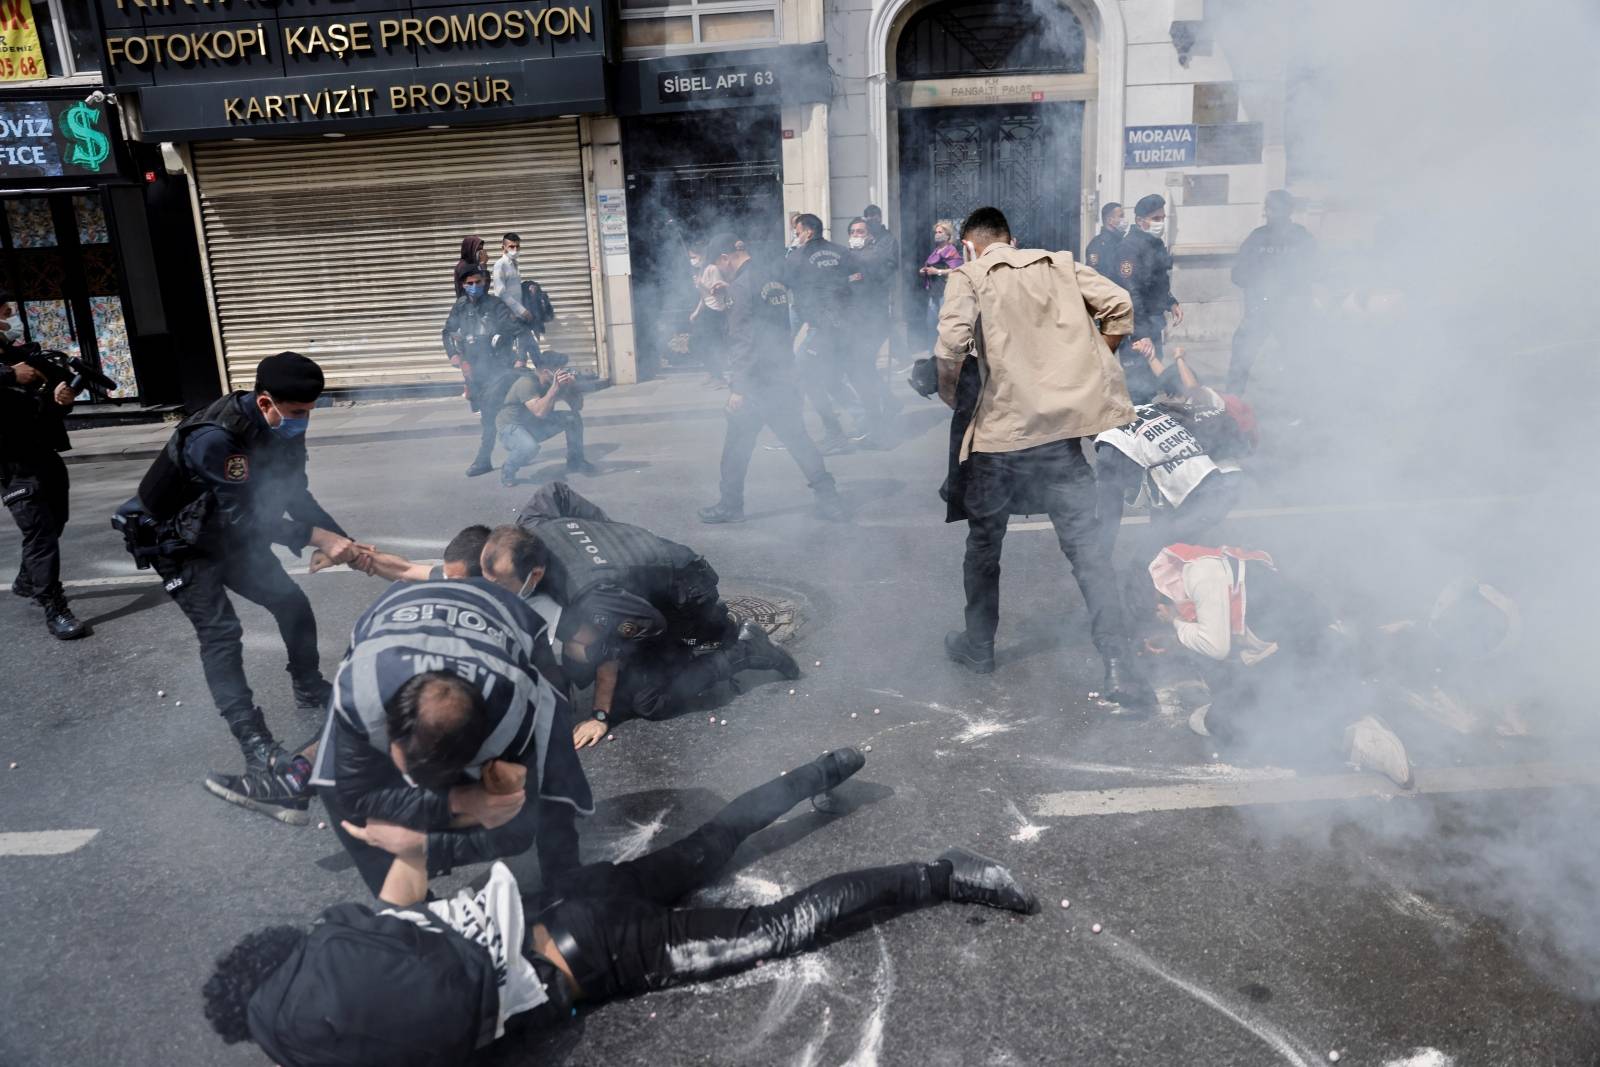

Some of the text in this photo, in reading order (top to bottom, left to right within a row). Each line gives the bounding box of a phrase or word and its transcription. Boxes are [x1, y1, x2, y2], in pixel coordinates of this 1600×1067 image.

[106, 5, 591, 66] FOTOKOPİ KAŞE PROMOSYON
[20, 56, 38, 76] 68
[664, 71, 774, 93] SİBEL APT 63
[223, 75, 513, 121] KARTVİZİT BROŞÜR
[1128, 128, 1192, 144] MORAVA
[1133, 145, 1186, 163] TURİZM
